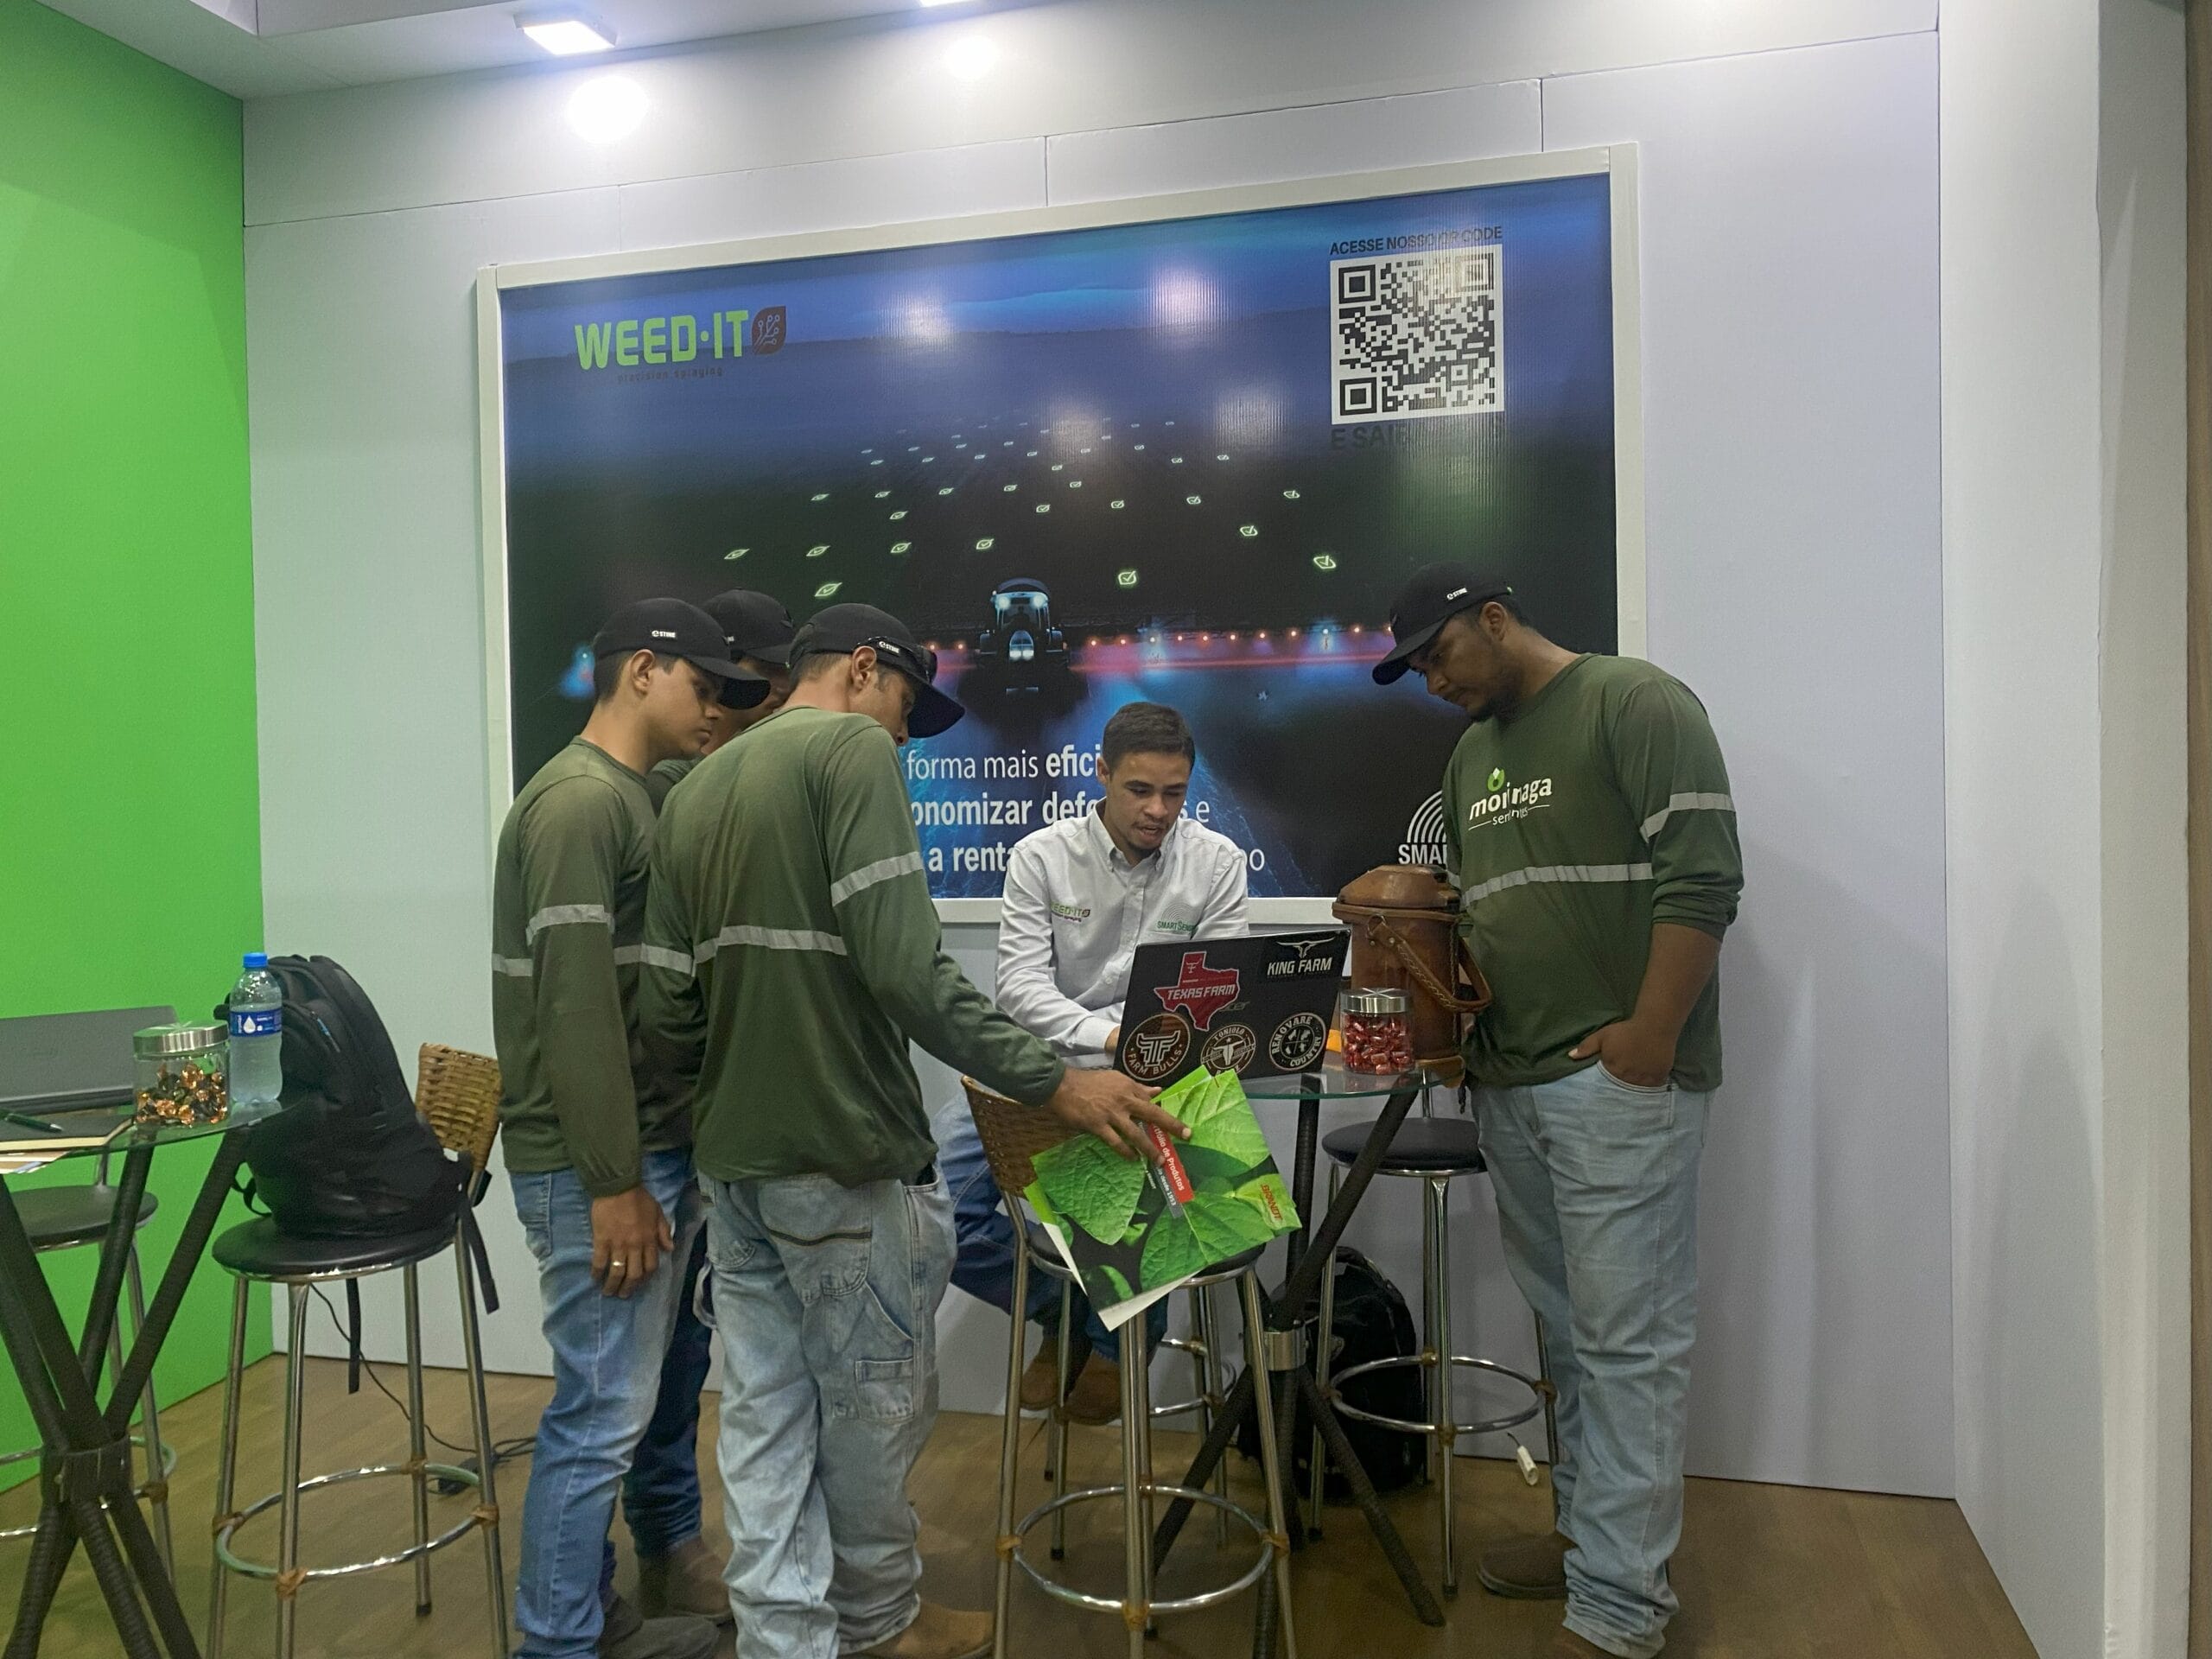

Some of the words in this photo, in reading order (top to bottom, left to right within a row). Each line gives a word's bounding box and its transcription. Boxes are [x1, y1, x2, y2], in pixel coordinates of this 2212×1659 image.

[1330, 238, 1383, 255] ACESSE
[1386, 232, 1434, 250] NOSSO
[1462, 226, 1503, 242] CODE
[907, 749, 976, 779] forma
[984, 749, 1039, 779] mais
[1046, 744, 1101, 777] efici
[911, 792, 1033, 825] onomizar
[1196, 801, 1210, 823] e
[928, 847, 943, 872] a
[1267, 961, 1295, 976] KING
[1298, 957, 1332, 973] FARM
[1167, 988, 1203, 1001] TEXAS
[1203, 984, 1236, 997] FARM
[1271, 1015, 1313, 1054] RENOVARE
[1128, 1053, 1148, 1075] FARM
[1153, 1049, 1182, 1075] BULLS
[1290, 1036, 1322, 1067] COUNTRY
[1166, 1157, 1185, 1191] Produtos
